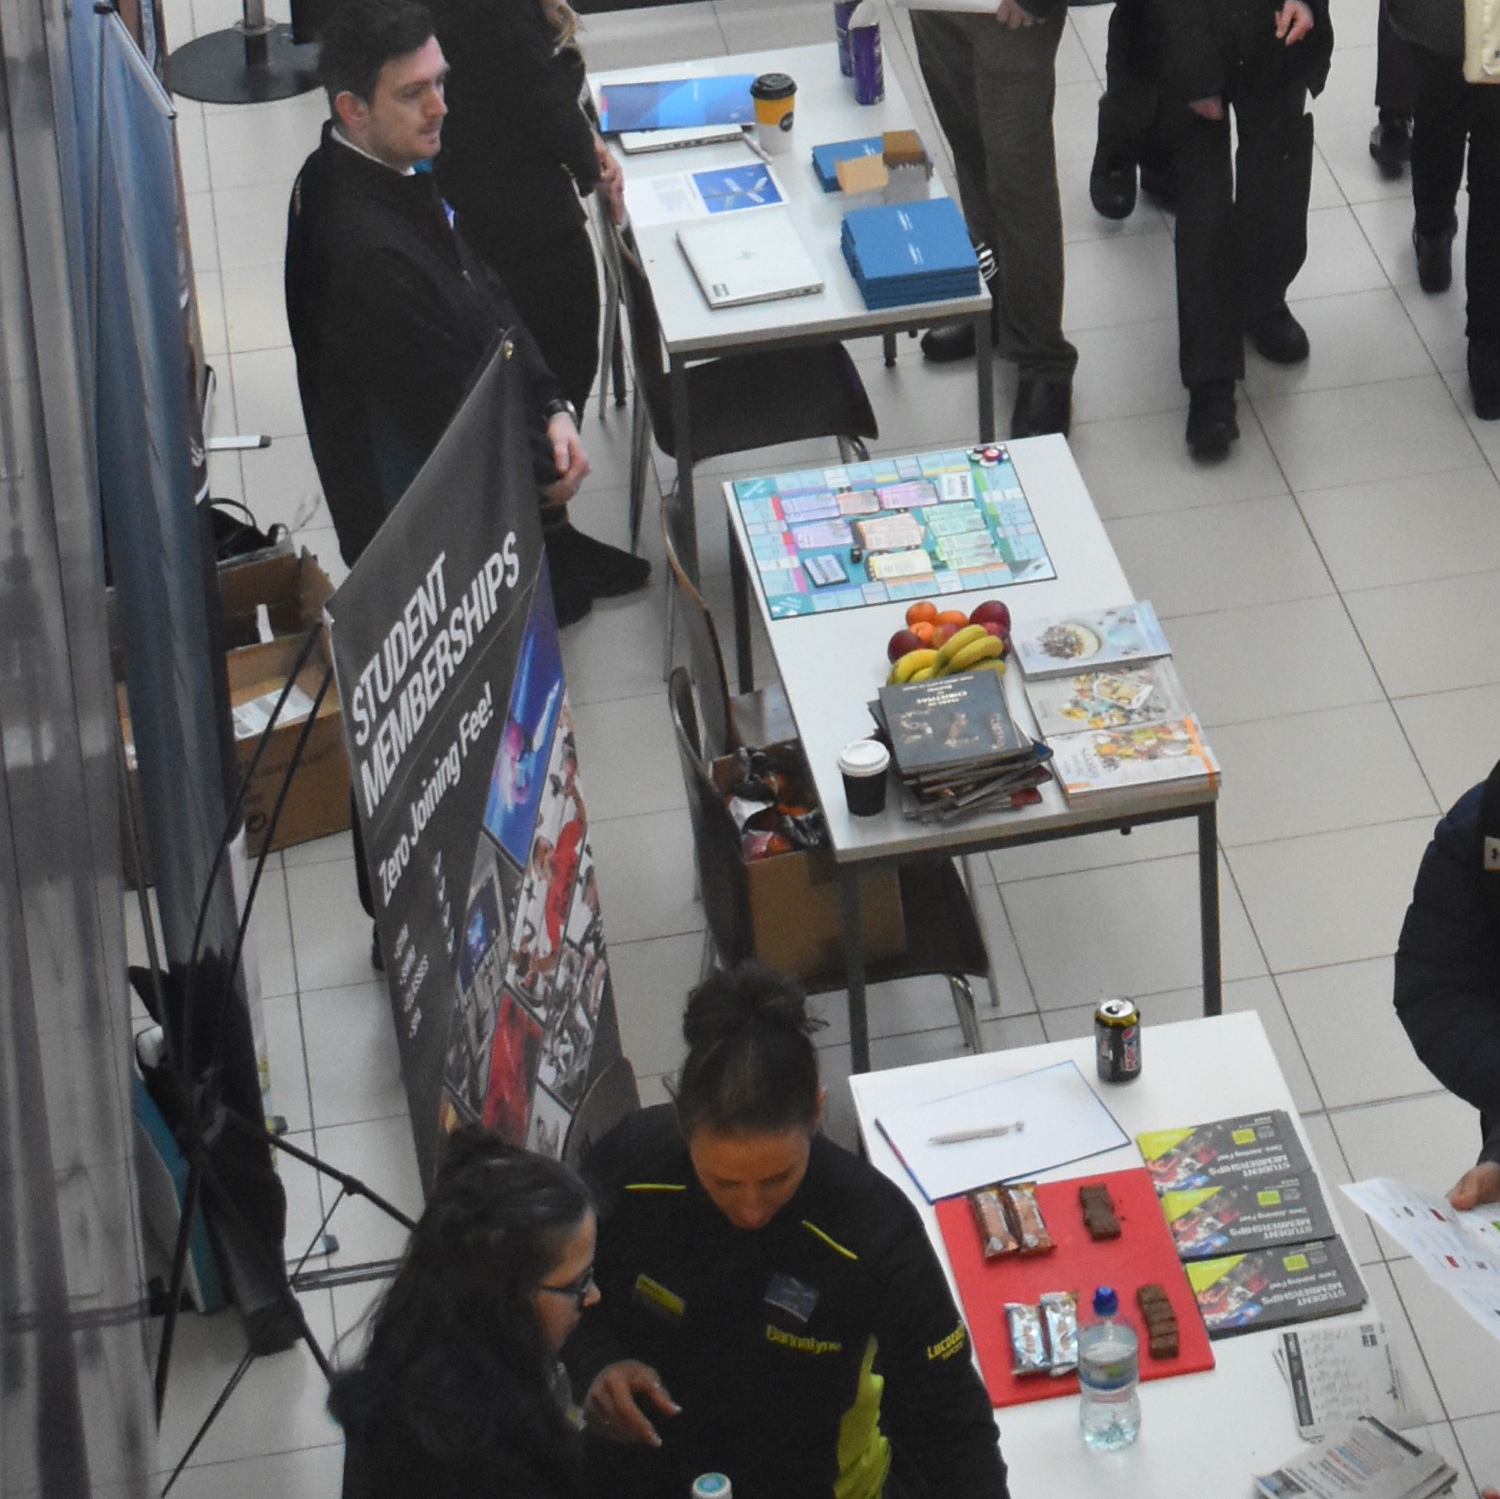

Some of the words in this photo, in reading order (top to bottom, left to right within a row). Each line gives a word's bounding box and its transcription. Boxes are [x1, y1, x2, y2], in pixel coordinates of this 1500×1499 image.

[351, 551, 448, 747] STUDENT
[360, 531, 521, 818] MEMBERSHIPS
[378, 832, 411, 907] Zero
[410, 738, 462, 845] Joining
[458, 681, 494, 759] Fee!
[1208, 1155, 1290, 1176] MEMBERSHIPS
[1242, 1162, 1292, 1178] STUDENT
[1229, 1217, 1312, 1236] MEMBERSHIPS
[1264, 1224, 1313, 1240] STUDENT
[1261, 1281, 1344, 1305] MEMBERSHIPS
[1297, 1287, 1347, 1306] STUDENT
